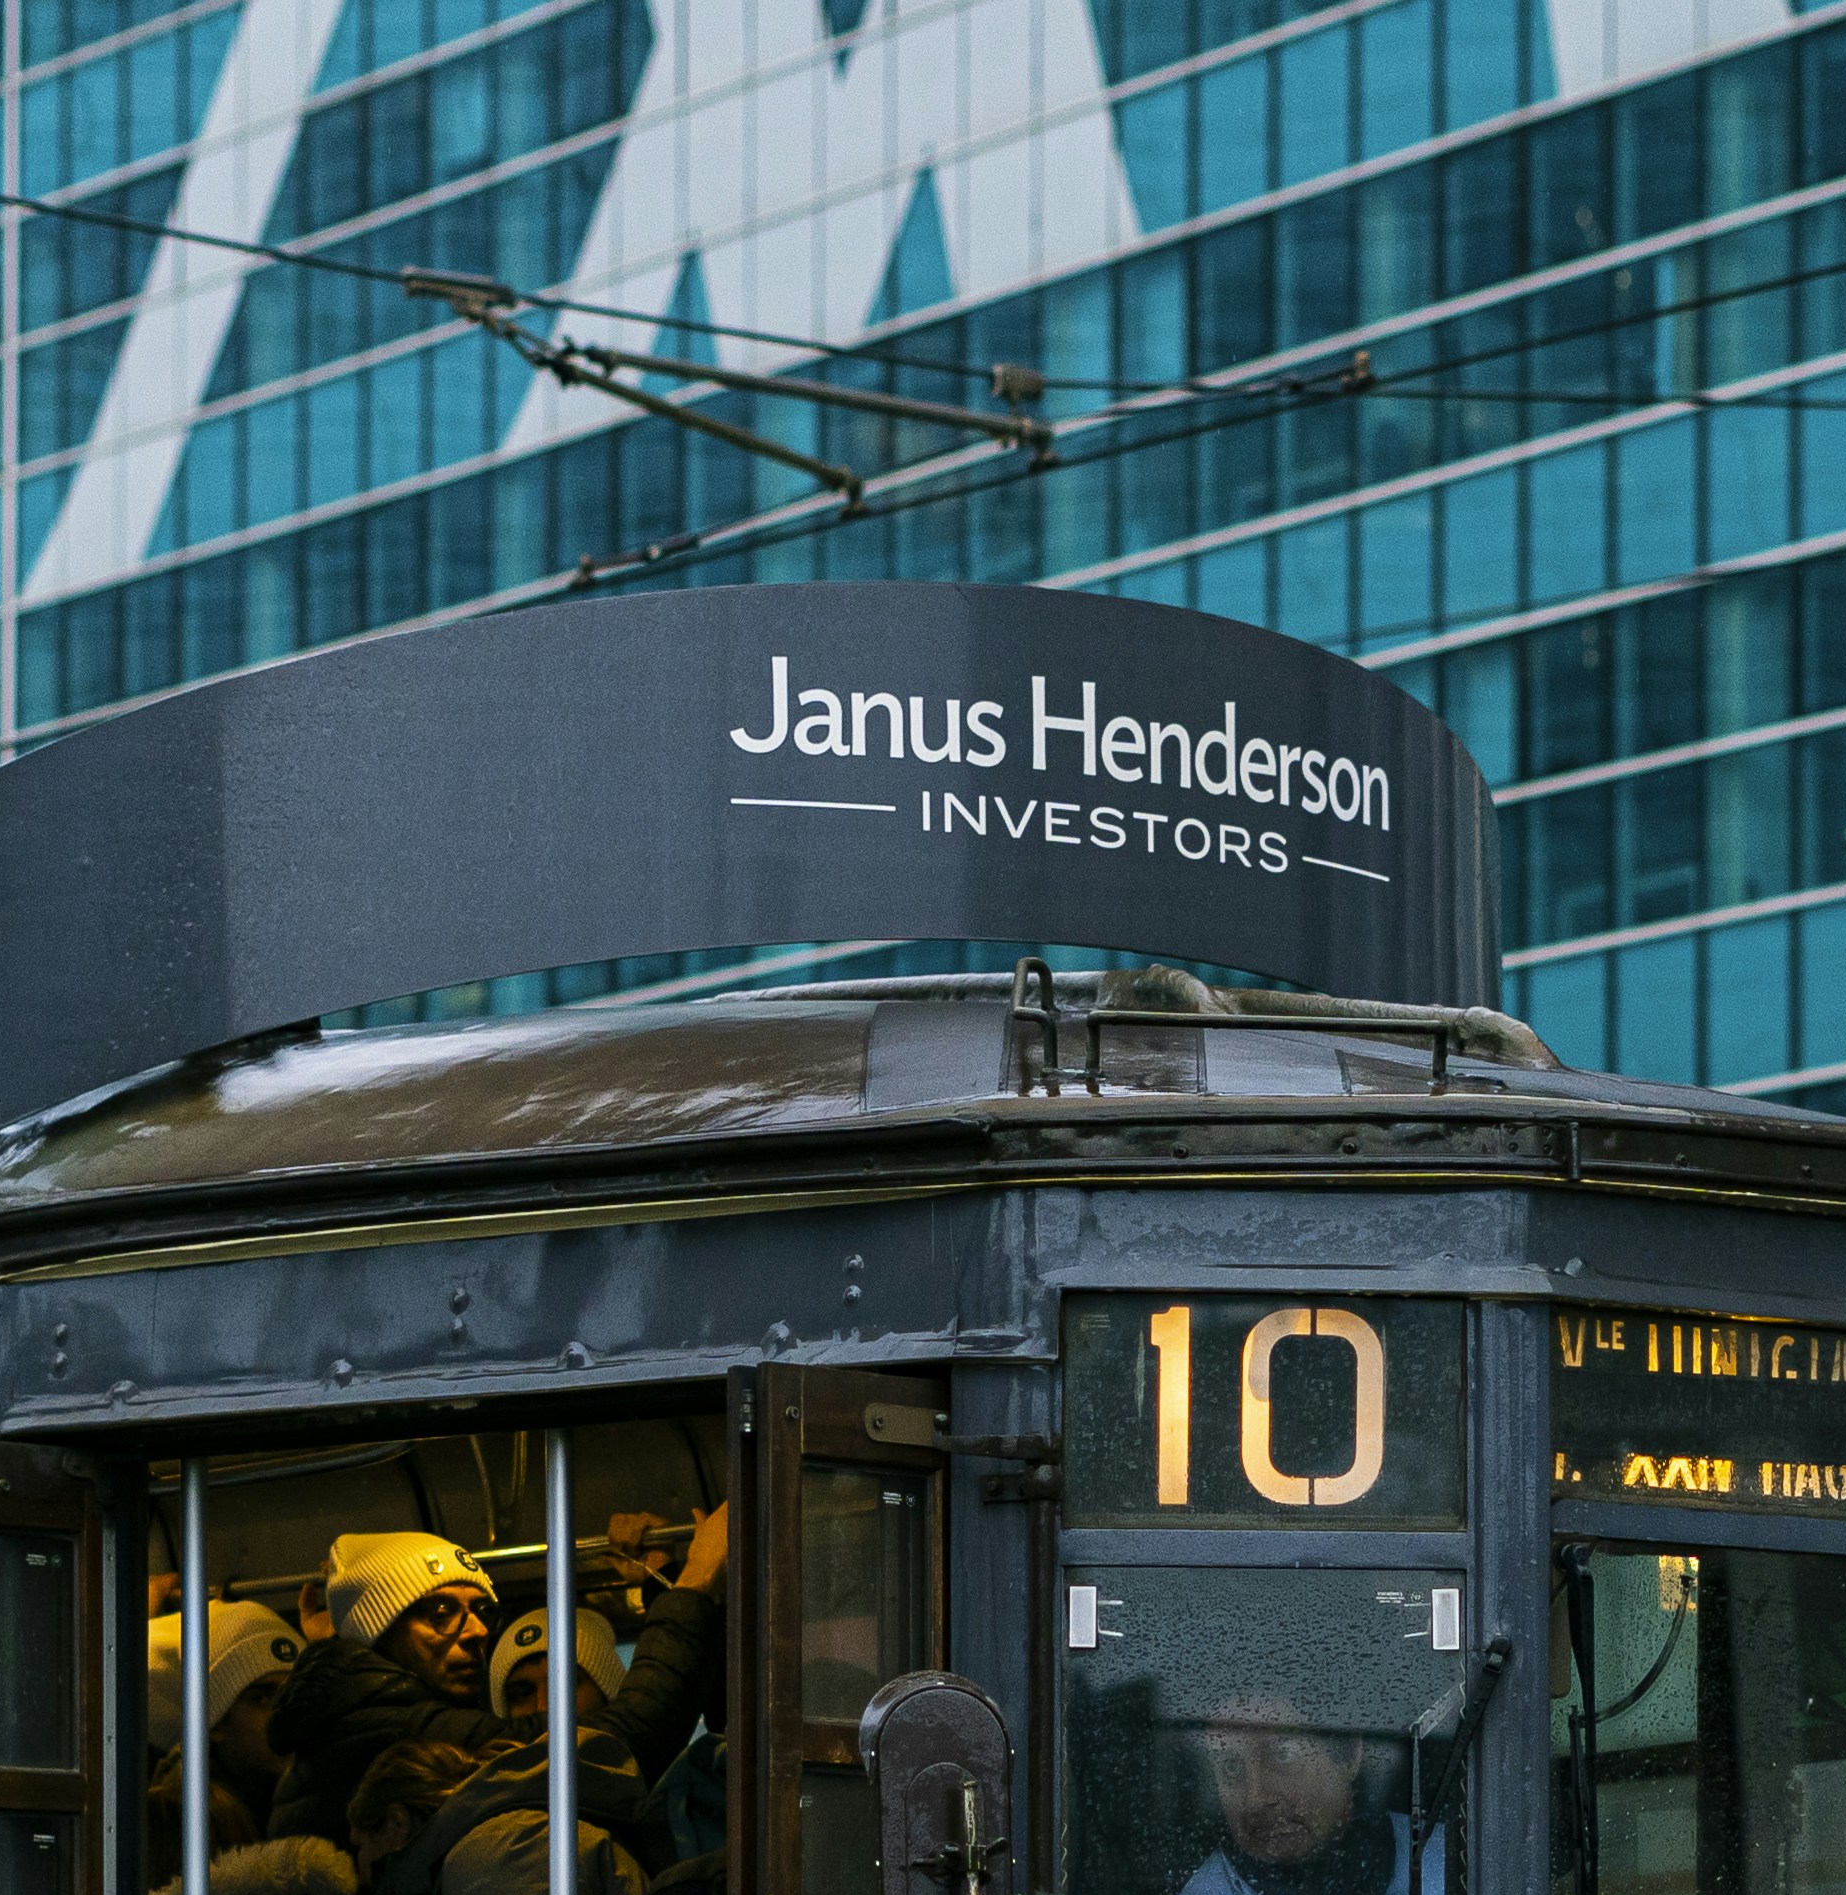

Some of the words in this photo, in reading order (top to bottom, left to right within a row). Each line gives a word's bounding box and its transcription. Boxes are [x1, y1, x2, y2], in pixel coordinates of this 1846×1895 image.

[729, 656, 1006, 768] Janus
[1031, 675, 1390, 831] Henderson
[921, 790, 1290, 874] INVESTORS
[1150, 1306, 1385, 1507] 10
